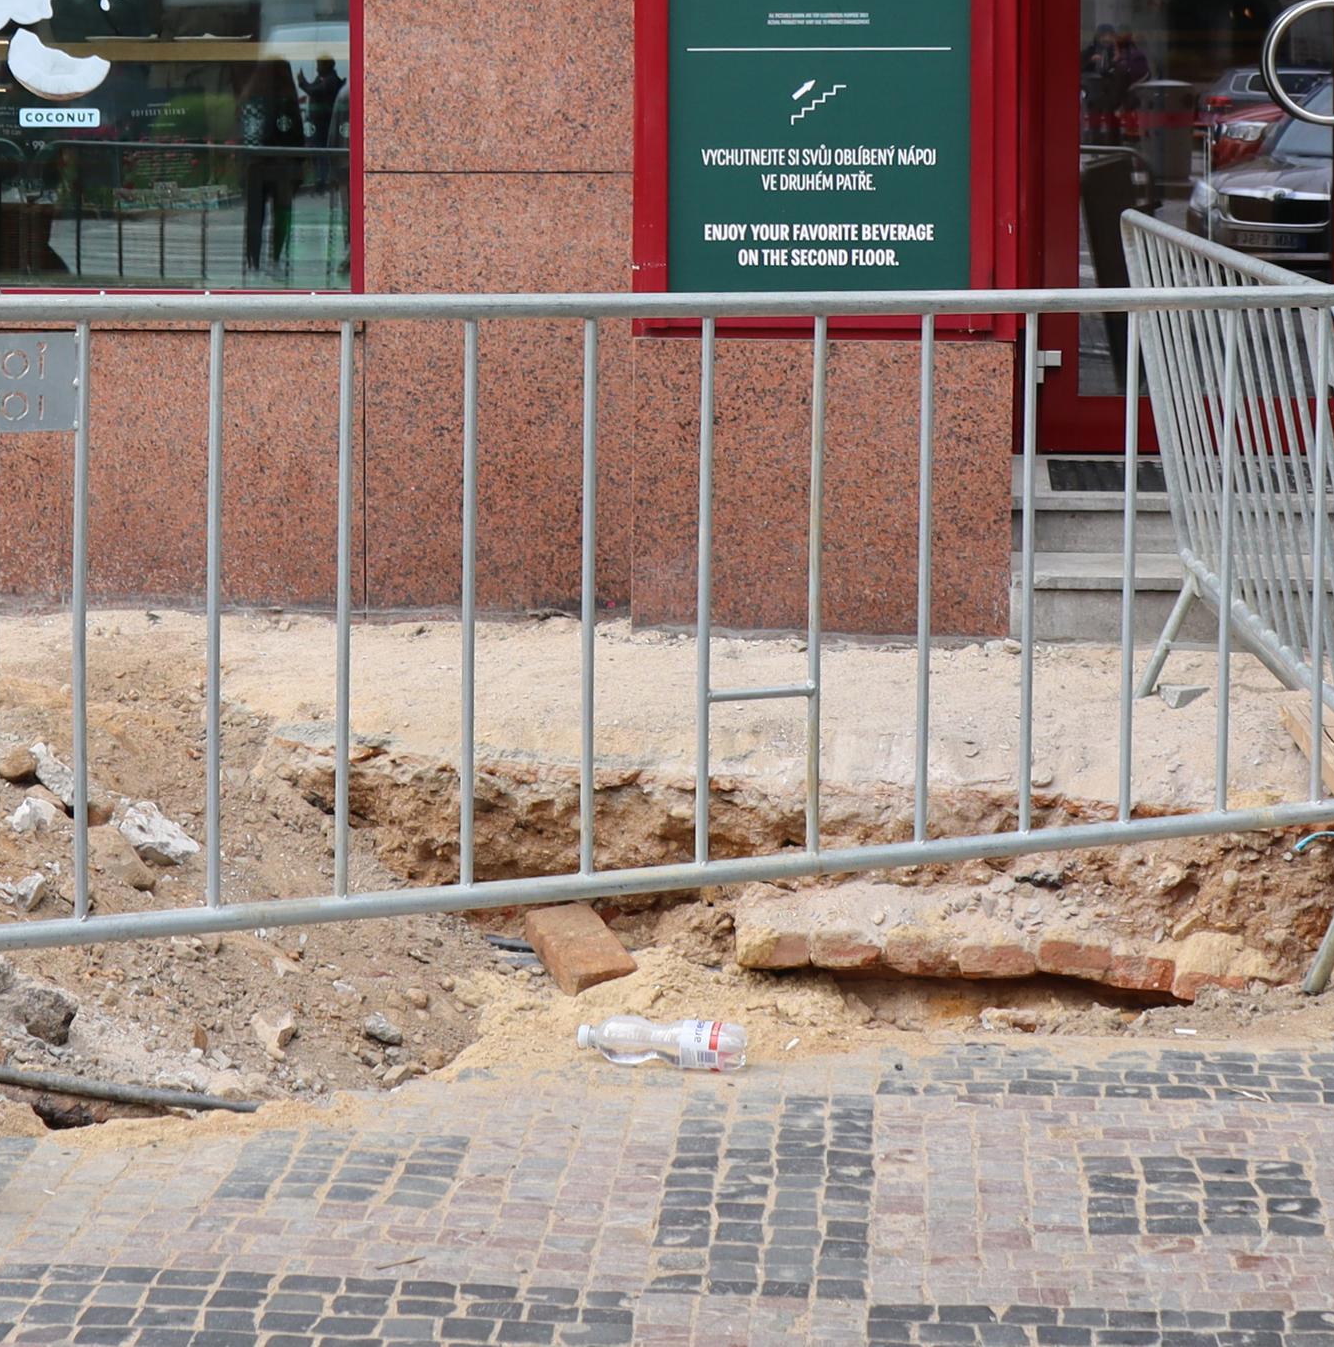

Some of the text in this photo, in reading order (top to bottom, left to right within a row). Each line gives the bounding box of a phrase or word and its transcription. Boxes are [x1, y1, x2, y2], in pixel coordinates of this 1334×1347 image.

[24, 111, 96, 125] COCONUT
[701, 144, 937, 166] VYCHUTNEJTE SI SVŮJ OBLÍBENÝ NÁPOJ
[762, 171, 876, 191] VE DRUHÉM PATŘE.
[704, 224, 934, 241] ENJOY YOUR FAVORITE BEVERAGE
[738, 249, 899, 266] ON THE SECOND FLOOR.
